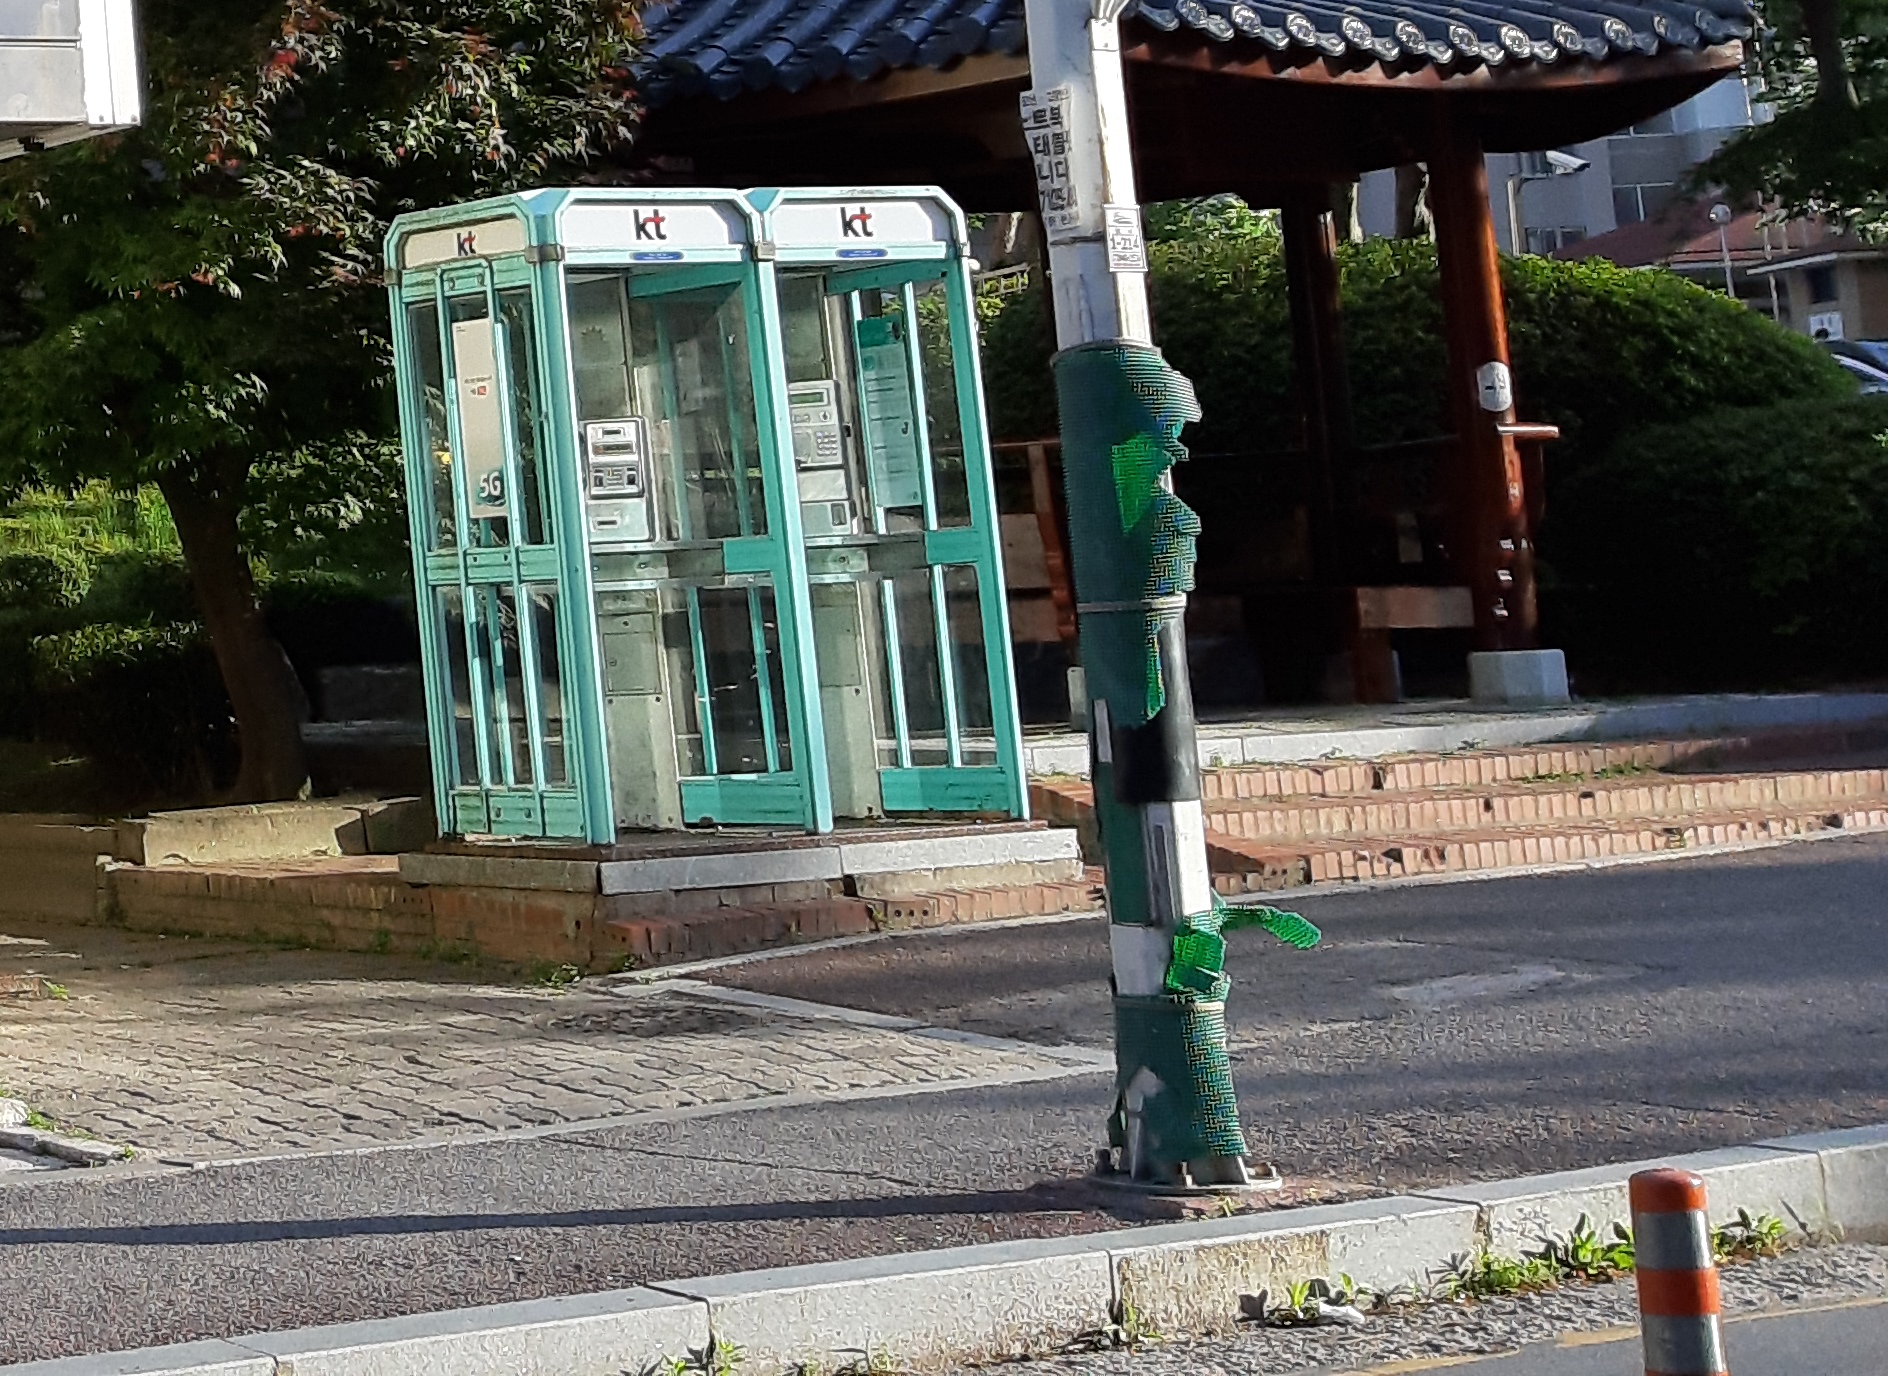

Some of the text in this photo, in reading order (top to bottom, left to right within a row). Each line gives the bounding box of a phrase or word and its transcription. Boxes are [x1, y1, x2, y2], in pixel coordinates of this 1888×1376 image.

[633, 208, 667, 240] kt
[841, 206, 875, 238] kt
[457, 232, 476, 257] kt
[479, 472, 501, 498] 5G
